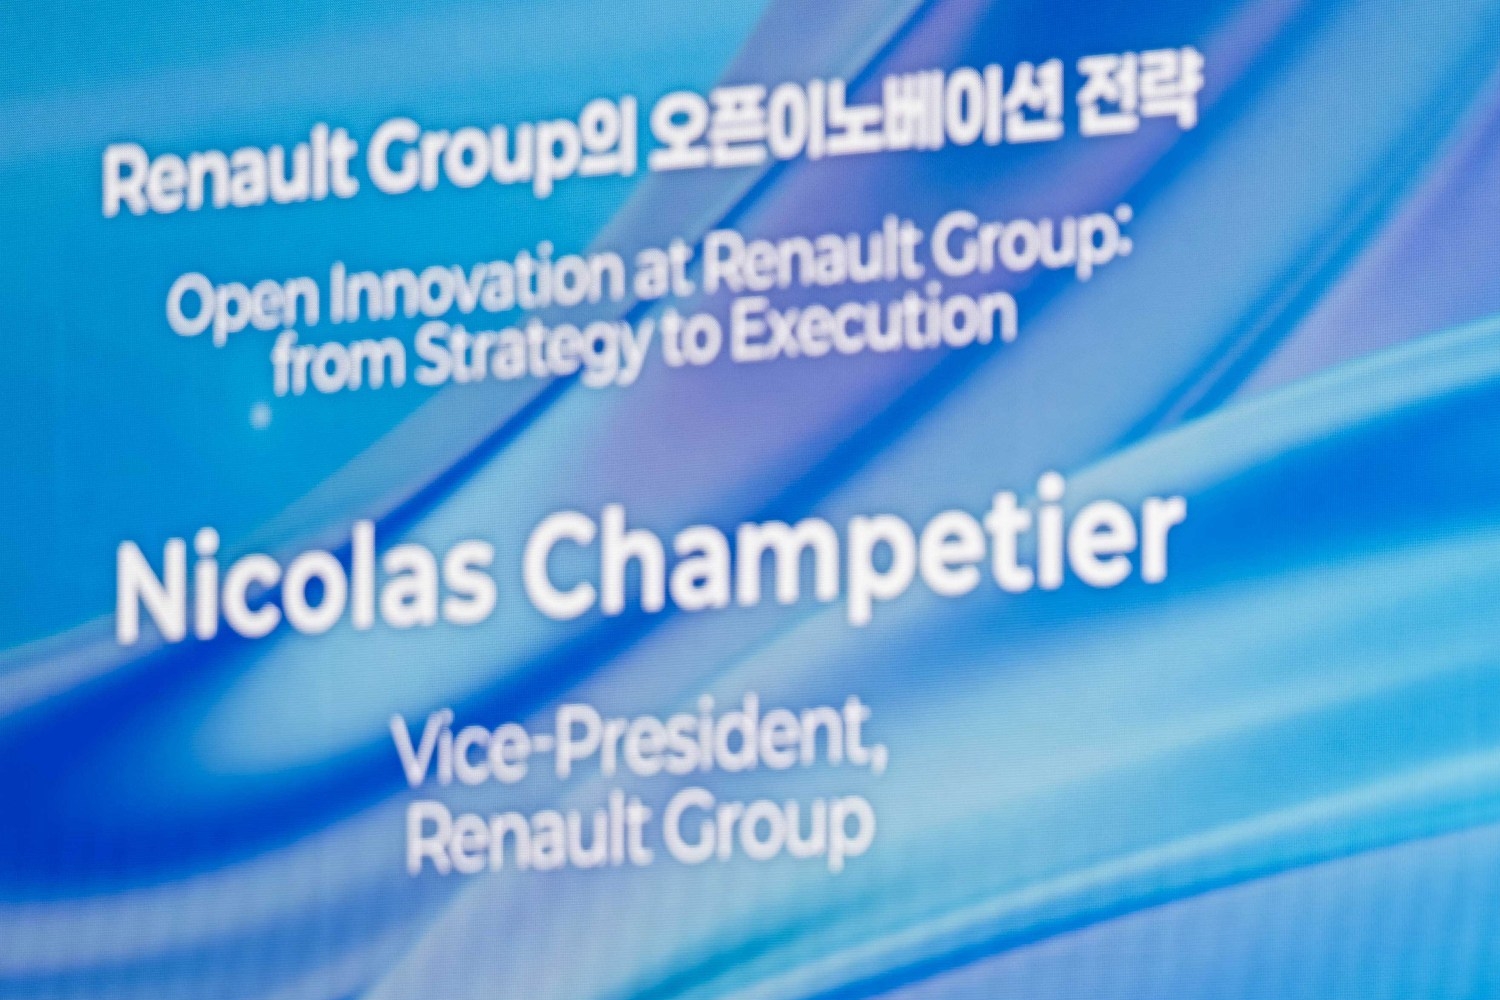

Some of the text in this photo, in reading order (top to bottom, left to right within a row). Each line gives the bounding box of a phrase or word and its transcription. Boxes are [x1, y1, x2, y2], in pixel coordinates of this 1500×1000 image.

[102, 46, 1204, 216] Renault Group의 오픈이노베이션 전략
[166, 205, 1134, 347] Open Innovation at Renault Group:
[269, 280, 1018, 396] from Strategy to Execution
[116, 471, 1187, 645] Nicolas Champetier
[390, 691, 889, 787] Vice-President,
[407, 786, 876, 876] Renault Group
